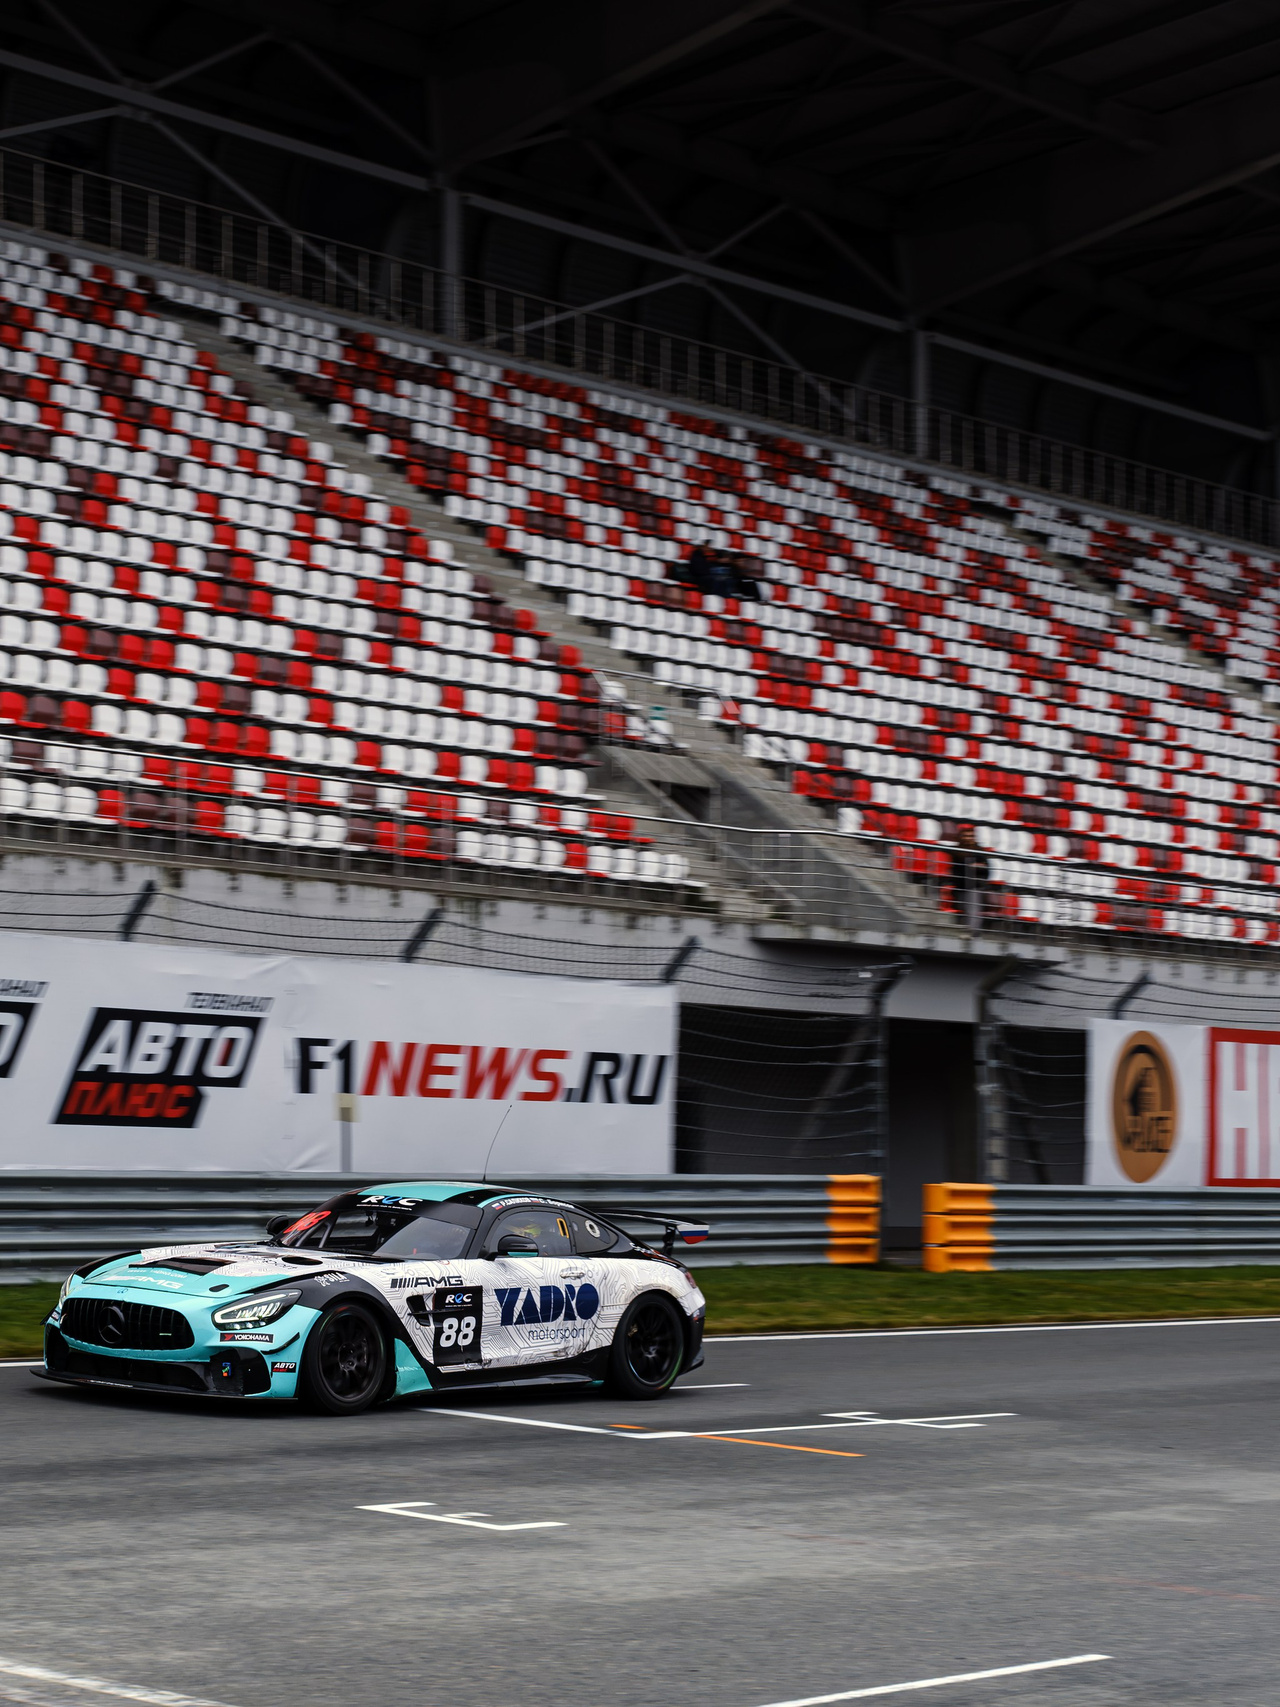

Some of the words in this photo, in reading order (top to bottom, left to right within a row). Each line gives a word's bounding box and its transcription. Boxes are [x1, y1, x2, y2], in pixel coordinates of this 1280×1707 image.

[78, 1019, 254, 1079] АВТО
[293, 1037, 671, 1106] F1NEWS.RU
[62, 1081, 197, 1119] ПЛЮС
[414, 1275, 464, 1288] AMG
[234, 1334, 270, 1342] YOKOHAMA
[440, 1316, 477, 1348] 88
[528, 1326, 586, 1341] motorsport
